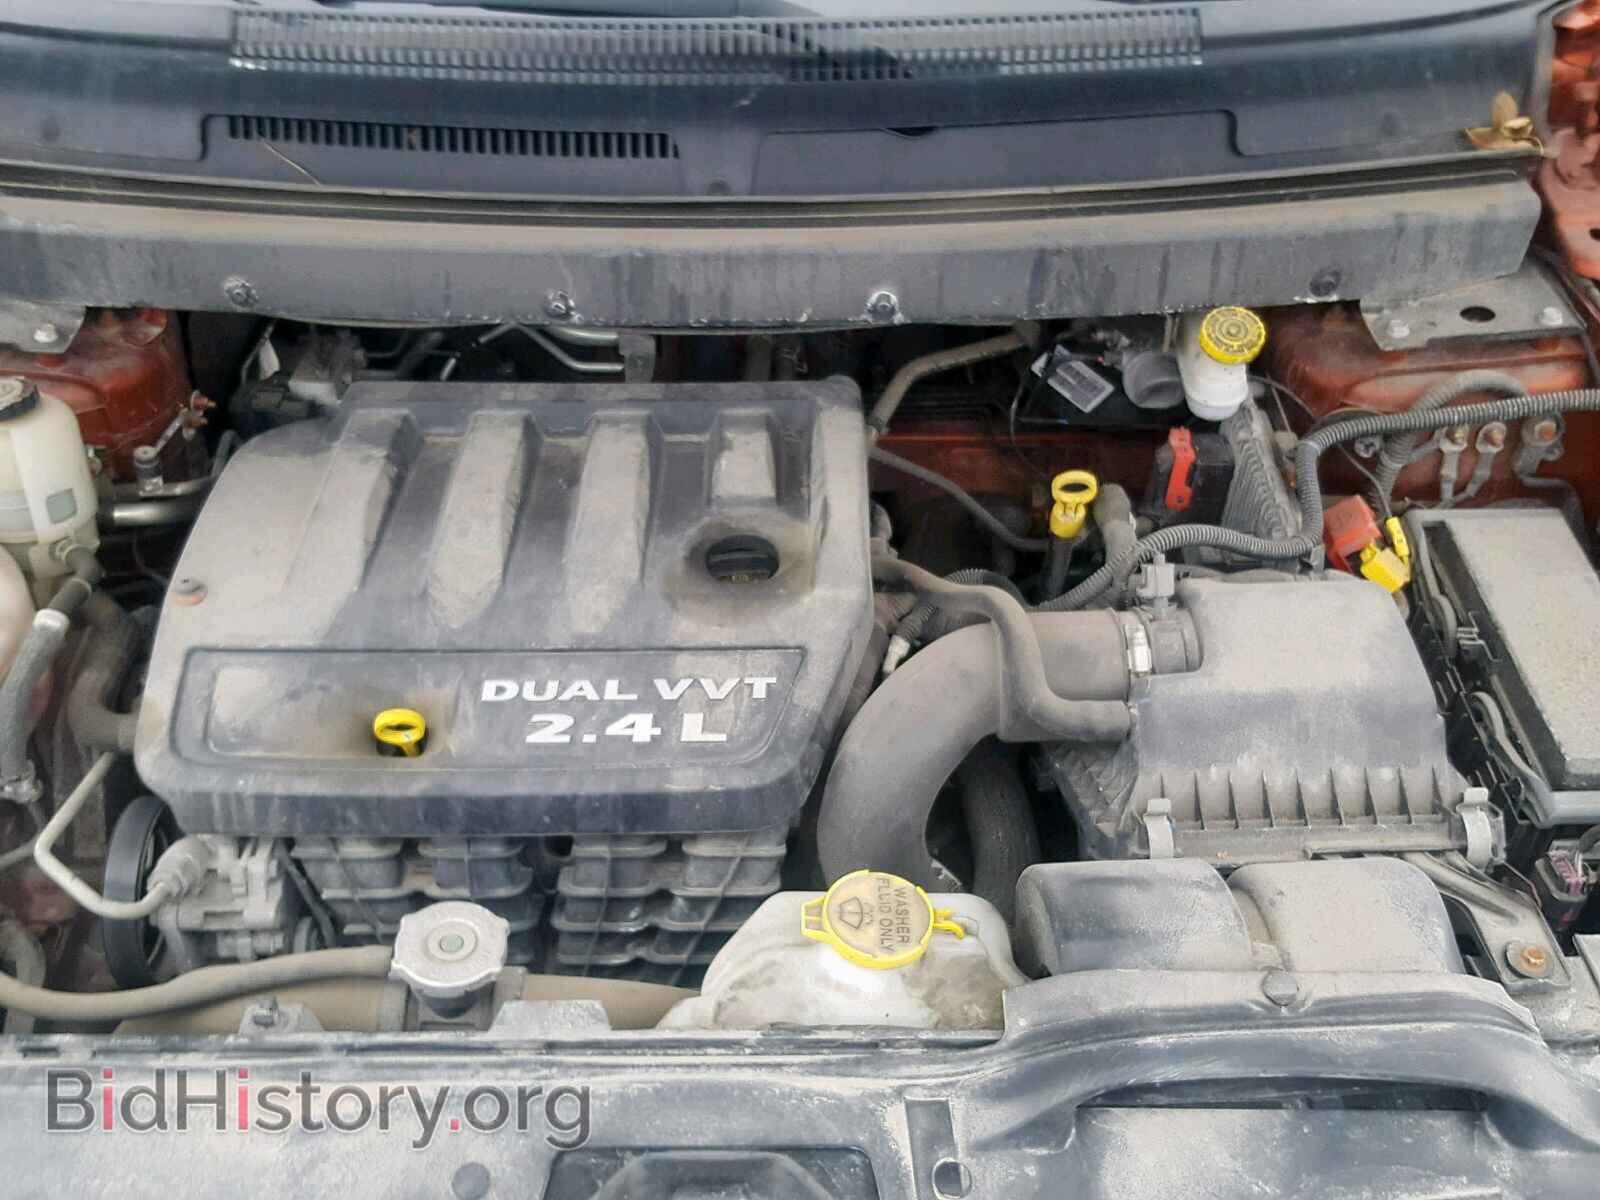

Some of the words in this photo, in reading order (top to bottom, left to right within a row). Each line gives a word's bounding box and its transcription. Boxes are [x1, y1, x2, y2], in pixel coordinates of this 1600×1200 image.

[480, 679, 638, 701] DUAL
[653, 677, 777, 701] VVT
[893, 886, 910, 945] WASHER
[879, 917, 895, 951] ONLY
